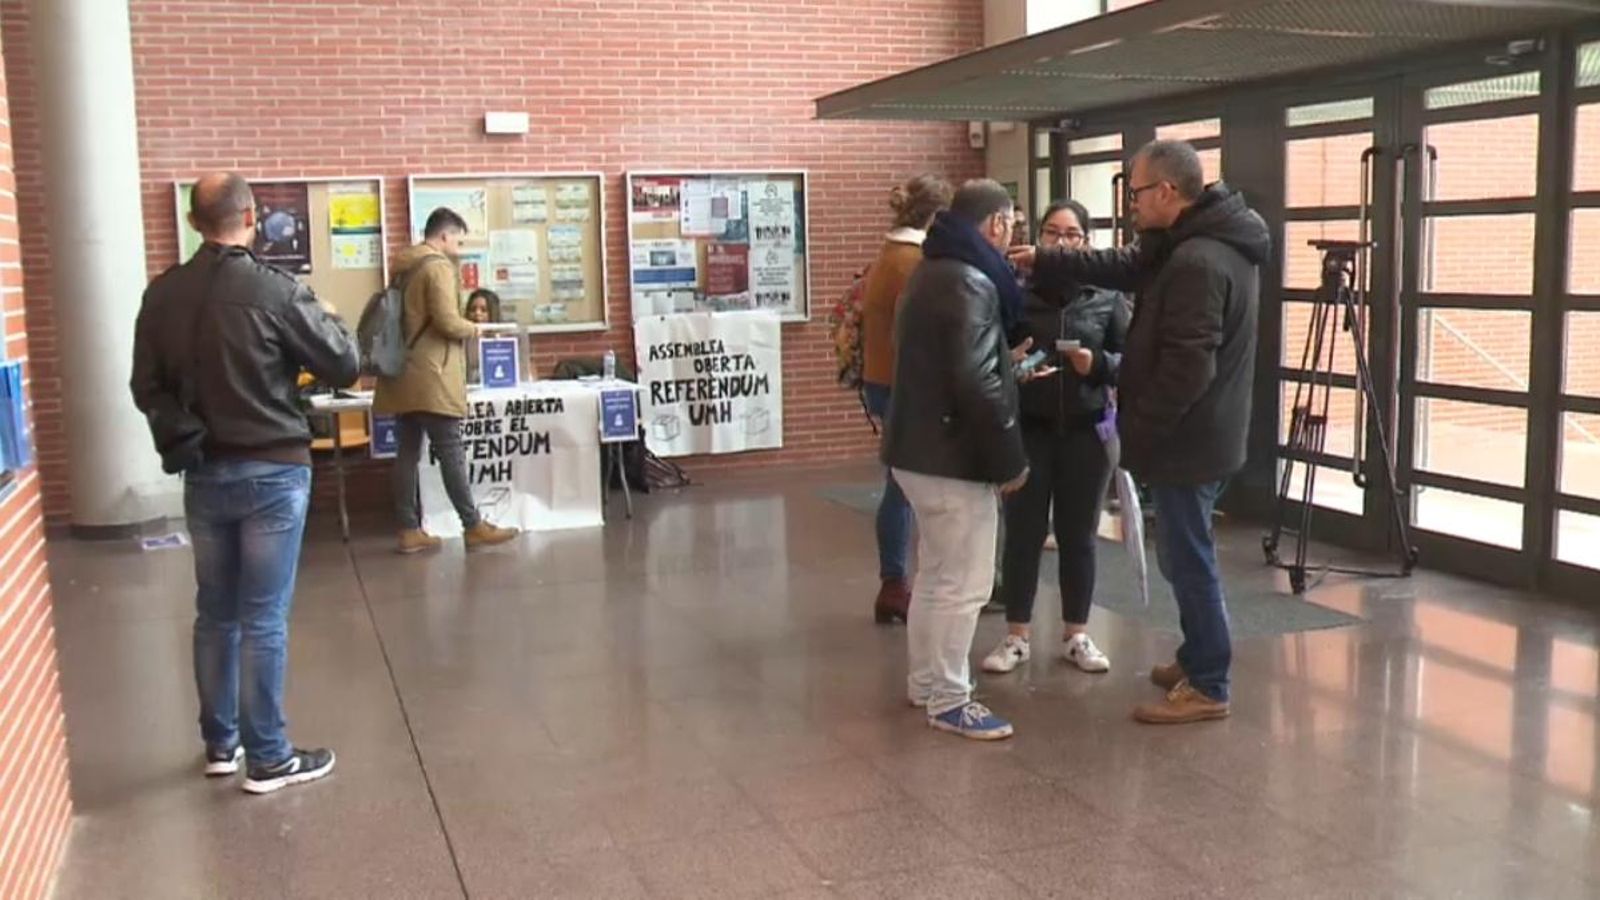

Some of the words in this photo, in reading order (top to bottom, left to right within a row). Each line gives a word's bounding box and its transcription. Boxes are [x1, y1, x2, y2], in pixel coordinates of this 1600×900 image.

[694, 354, 756, 373] OBERTA
[466, 401, 496, 420] LEA
[505, 394, 564, 416] ABIERTA
[688, 400, 732, 426] UMH
[510, 417, 529, 432] EL
